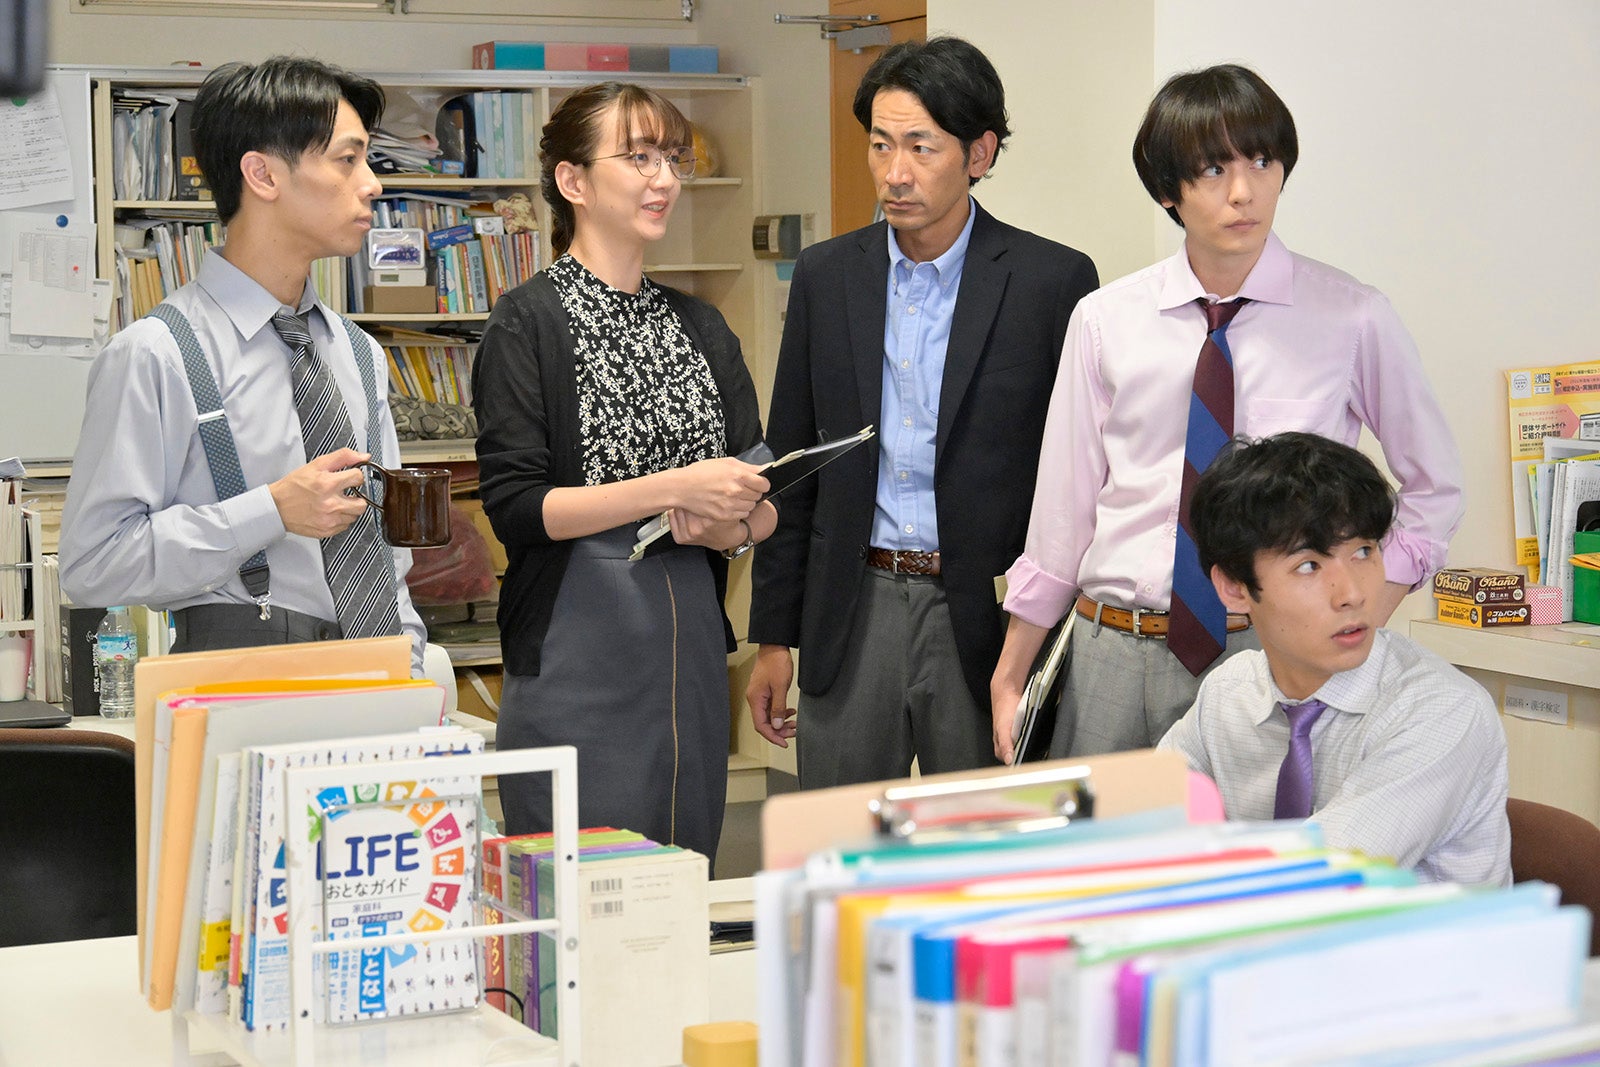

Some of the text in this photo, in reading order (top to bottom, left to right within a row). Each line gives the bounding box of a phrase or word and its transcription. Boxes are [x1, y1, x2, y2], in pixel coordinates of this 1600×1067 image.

[1522, 422, 1567, 432] 団体サポートサイト
[316, 829, 421, 881] LIFE
[326, 877, 410, 899] おとなガイド
